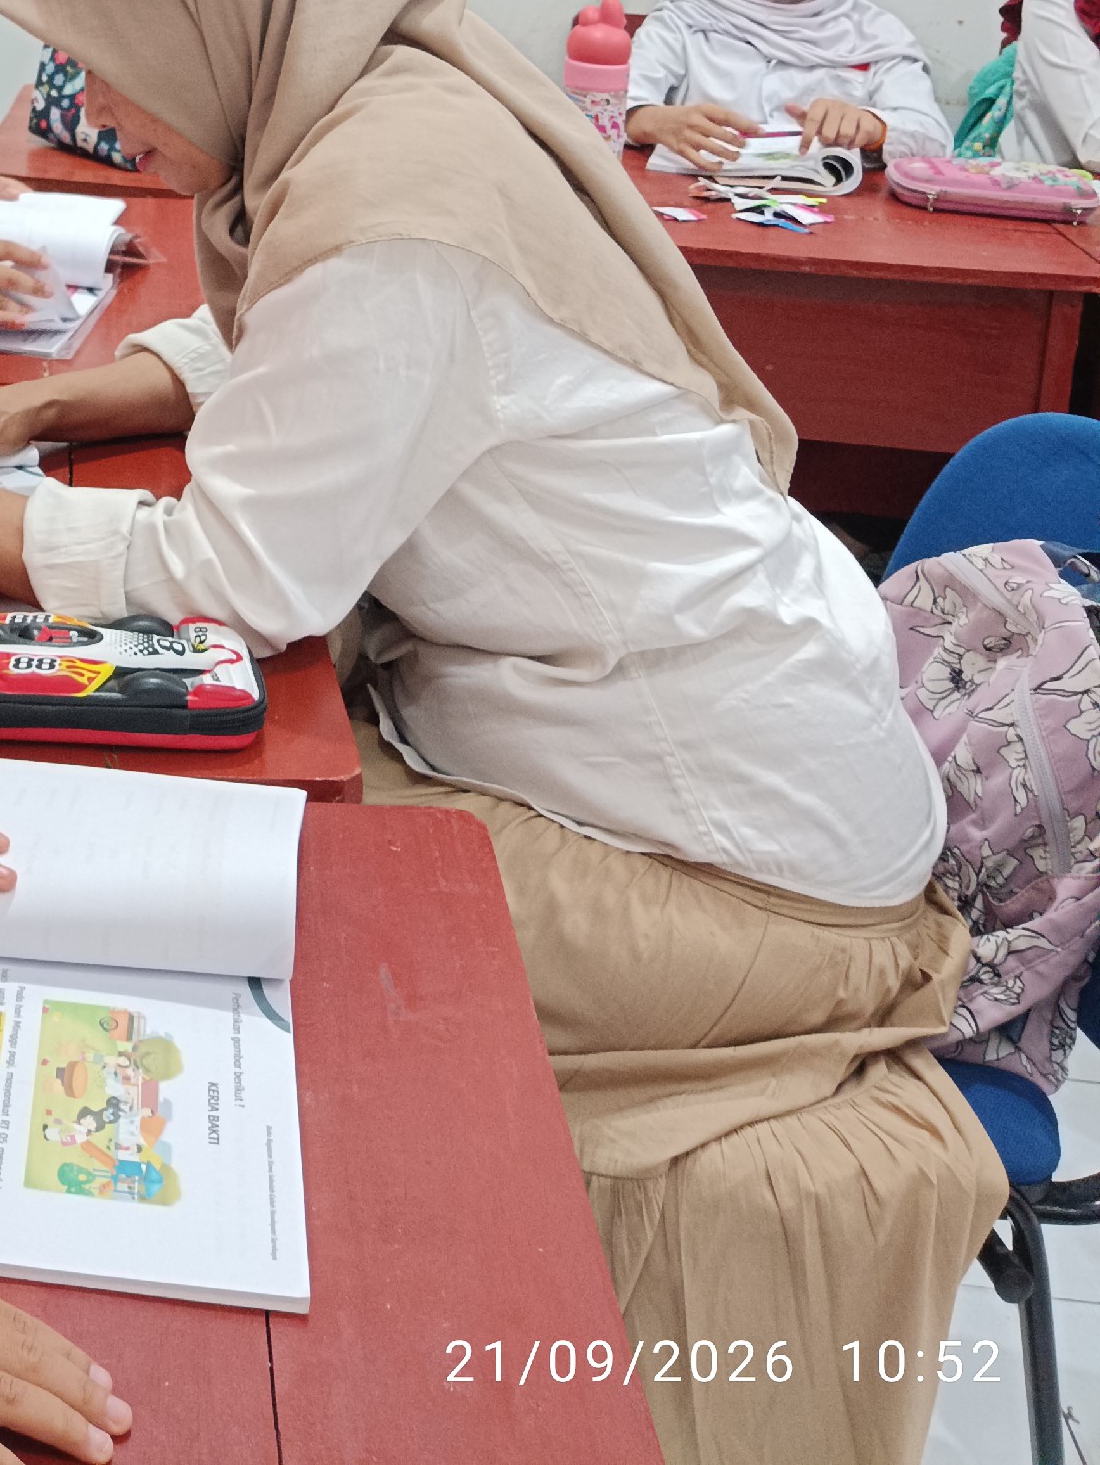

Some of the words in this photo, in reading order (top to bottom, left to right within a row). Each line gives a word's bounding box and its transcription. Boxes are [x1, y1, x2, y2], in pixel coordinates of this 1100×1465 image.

[11, 656, 57, 671] 88
[230, 1036, 242, 1068] gambar
[1, 1071, 13, 1116] masyarakat
[207, 1081, 219, 1111] KERJA
[233, 1071, 244, 1101] berikut
[0, 1119, 10, 1129] RT
[207, 1114, 219, 1144] BAKTI
